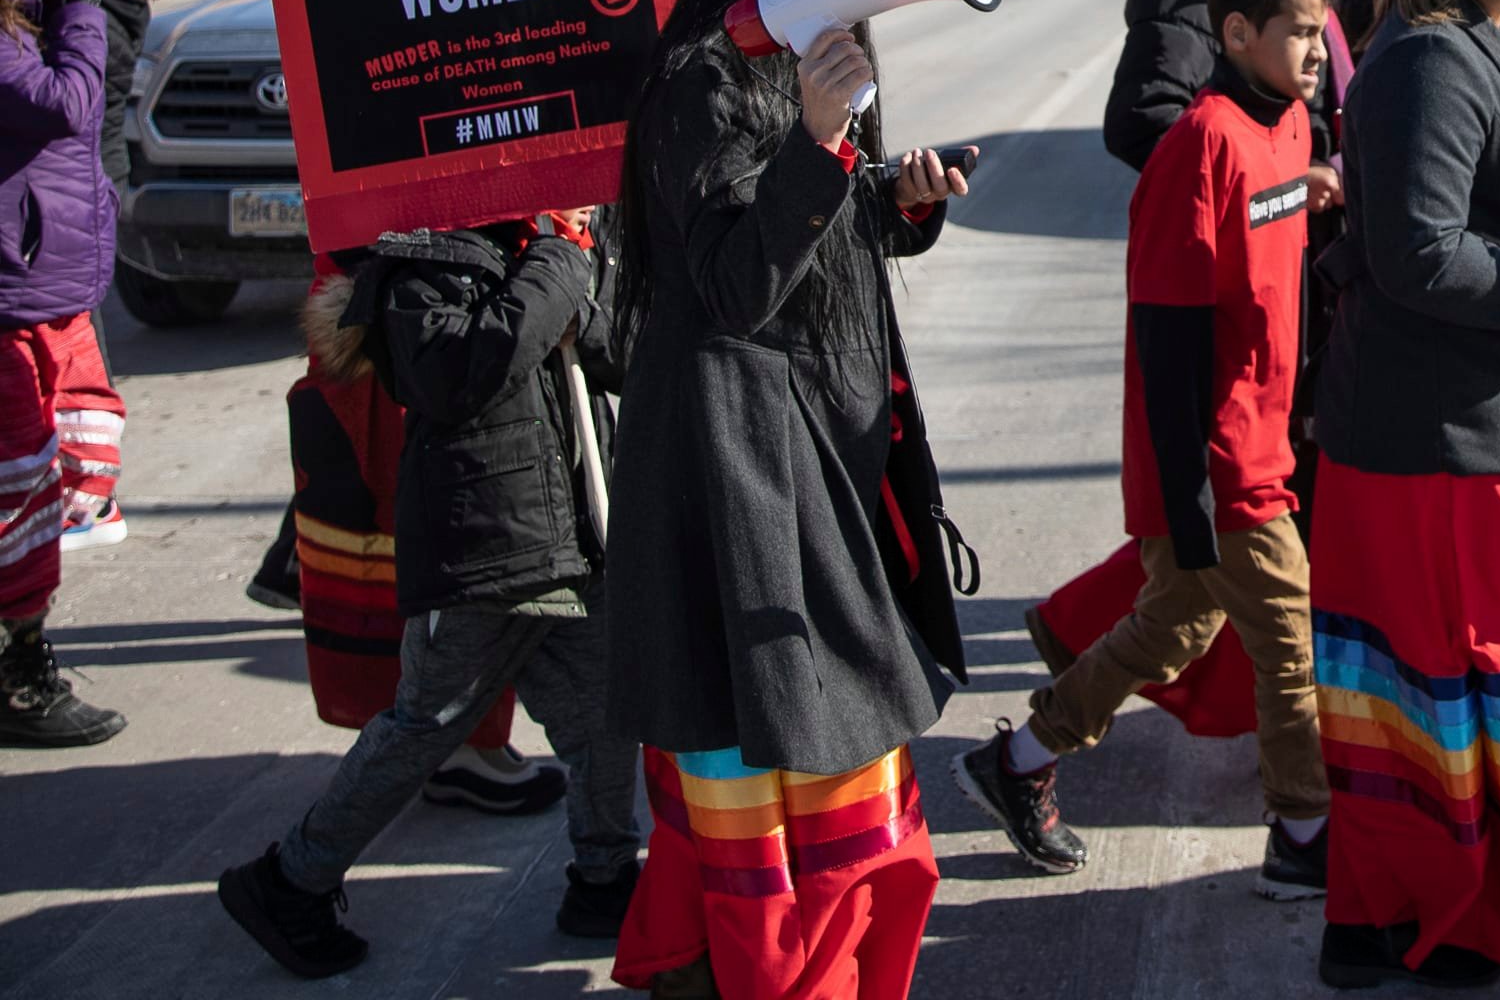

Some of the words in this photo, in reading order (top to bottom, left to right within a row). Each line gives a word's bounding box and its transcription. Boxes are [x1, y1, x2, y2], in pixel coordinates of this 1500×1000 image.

[365, 40, 441, 78] MURDER
[448, 41, 461, 54] is
[465, 35, 491, 51] the
[494, 27, 522, 46] 3rd
[525, 20, 587, 40] leading
[371, 75, 420, 91] cause
[424, 65, 440, 82] of
[443, 57, 497, 79] DEATH
[500, 50, 556, 69] among
[559, 40, 611, 58] Native
[462, 81, 523, 99] Women
[456, 105, 539, 144] #MMIW
[1268, 196, 1283, 220] you
